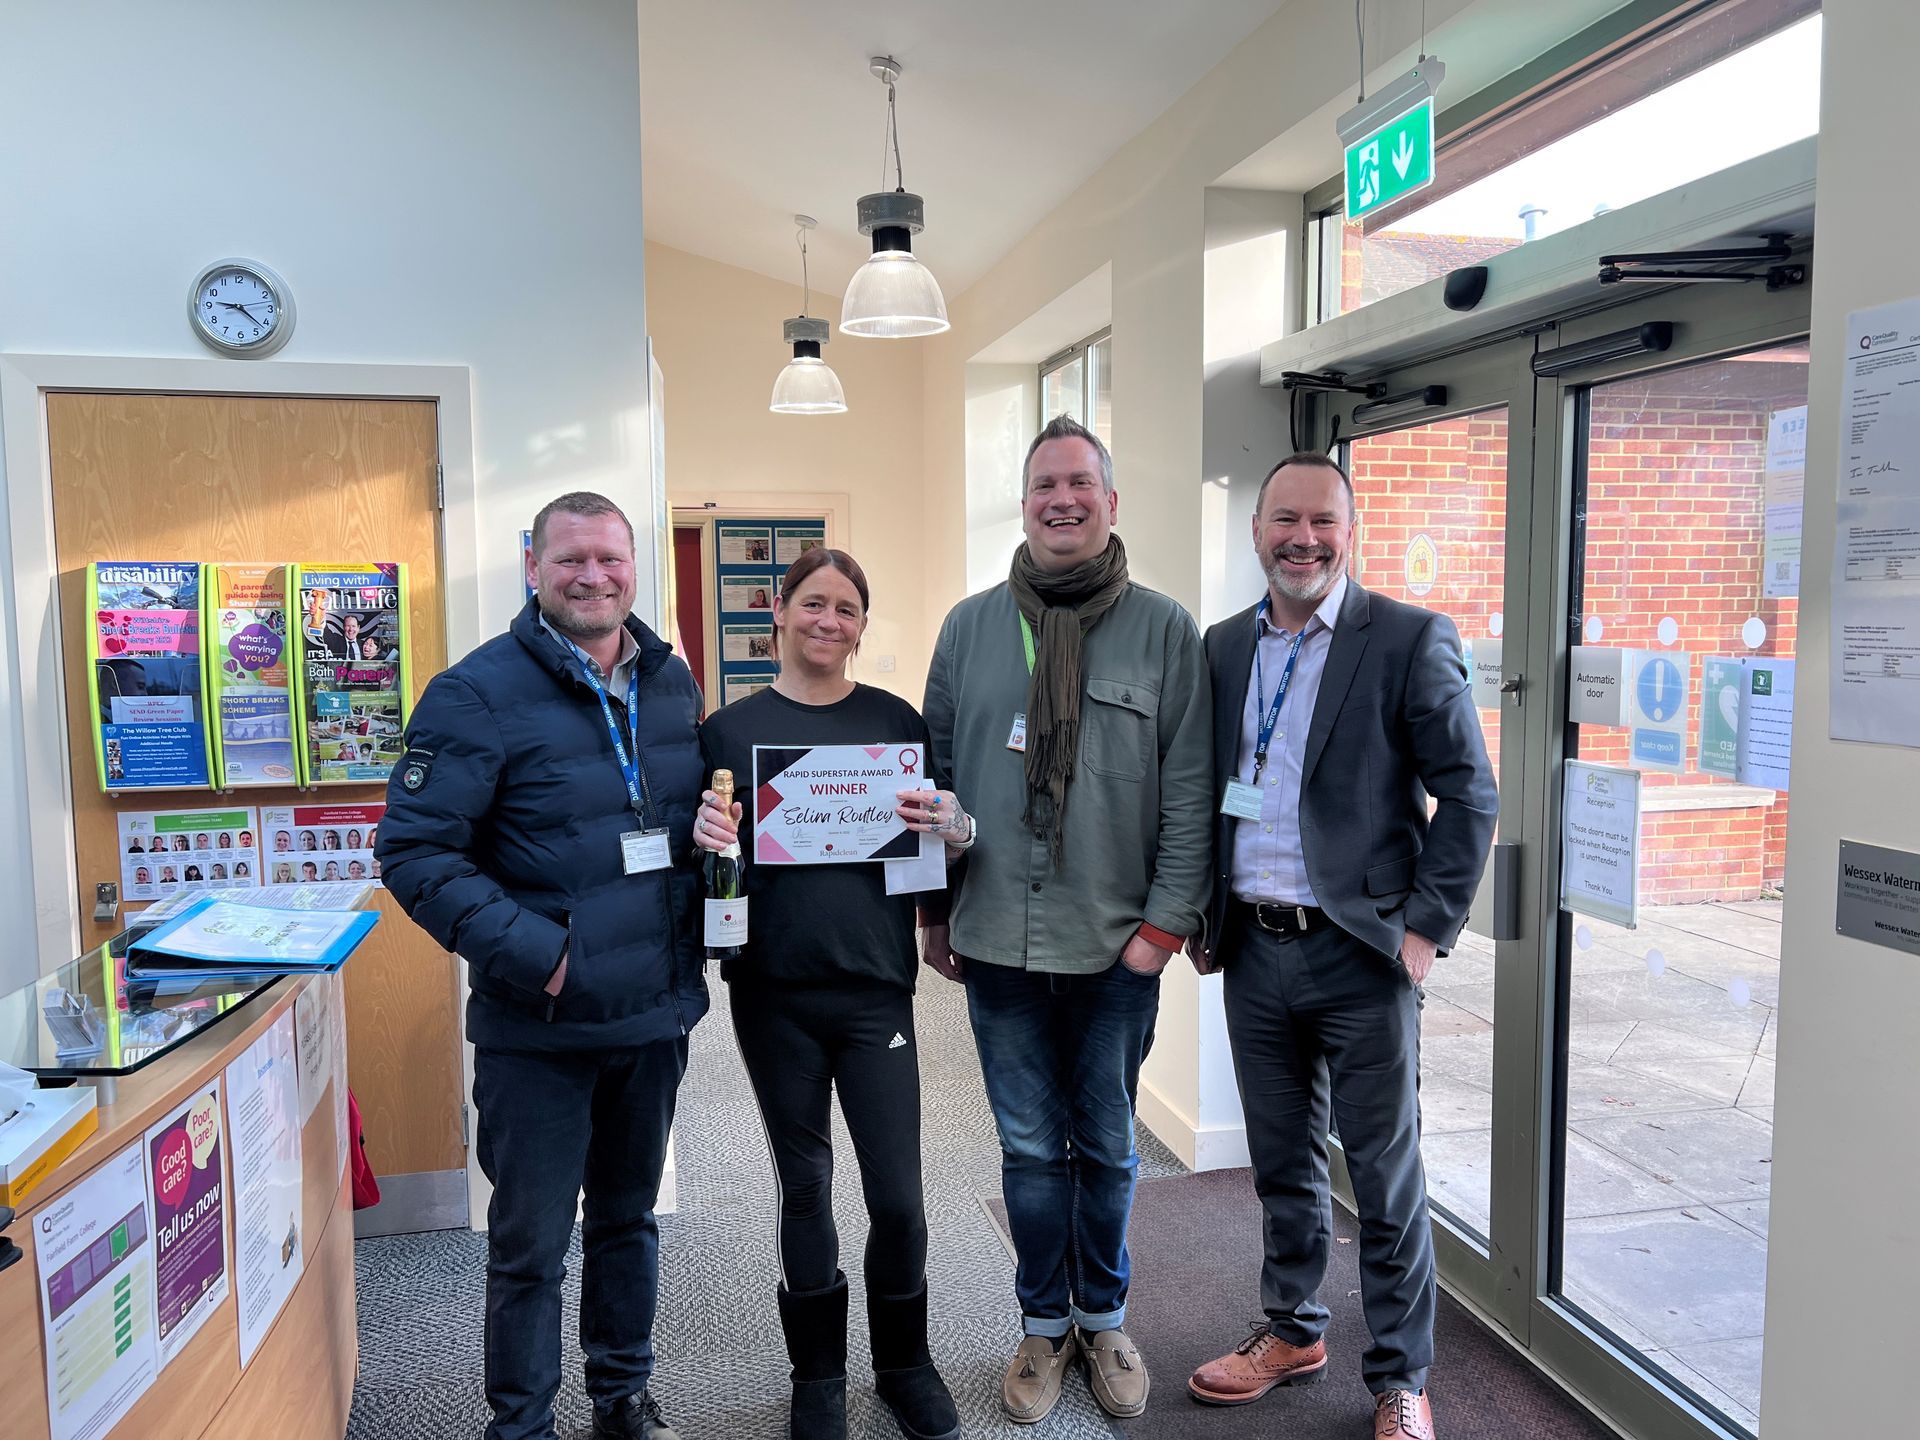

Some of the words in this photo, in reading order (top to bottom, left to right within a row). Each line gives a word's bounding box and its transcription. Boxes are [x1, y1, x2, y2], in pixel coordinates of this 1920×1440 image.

[235, 276, 244, 284] 12
[210, 289, 218, 297] 10
[262, 291, 268, 299] 2
[267, 305, 274, 313] 3
[211, 316, 217, 324] 8
[263, 318, 269, 326] 4
[224, 326, 229, 334] 7
[238, 331, 244, 339] 6
[253, 328, 259, 336] 5
[100, 568, 196, 586] disability
[304, 575, 339, 587] Living
[342, 574, 370, 585] with
[225, 592, 249, 600] guide
[356, 588, 397, 609] Life
[100, 624, 125, 634] Short
[128, 624, 160, 634] Breaks
[163, 624, 198, 634] Bulletin
[239, 635, 267, 643] what's
[238, 644, 276, 655] worrying
[1291, 635, 1302, 658] VISITOR
[245, 655, 270, 663] you?
[309, 667, 334, 677] Bath
[336, 666, 394, 681] Parent
[584, 668, 600, 689] VISITOR
[1577, 673, 1615, 685] Automatic
[1279, 671, 1290, 694] VISITOR
[1485, 676, 1499, 684] door
[1586, 688, 1604, 698] door
[604, 704, 615, 728] VISITOR
[1266, 707, 1278, 729] VISITOR
[616, 742, 628, 767] VISITOR
[784, 770, 809, 778] RAPID
[811, 770, 858, 778] SUPERSTAR
[861, 769, 893, 777] AWARD
[629, 780, 639, 801] VISITO
[810, 783, 868, 795] WINNER
[1586, 797, 1615, 809] Reception
[782, 807, 831, 825] Selina
[837, 806, 893, 825] Routley
[1571, 823, 1587, 833] These
[1588, 827, 1604, 837] doors
[1605, 832, 1619, 840] must
[1621, 835, 1628, 843] be
[1569, 835, 1585, 845] locked
[1587, 840, 1601, 849] when
[1602, 843, 1630, 857] Reception
[820, 849, 858, 858] Rapidclean
[1586, 854, 1617, 867] unattended
[1844, 864, 1881, 883] Wessex
[1584, 880, 1600, 890] Thank
[1602, 885, 1613, 896] You
[1871, 888, 1899, 899] together
[1874, 920, 1899, 932] Wessex
[192, 1107, 210, 1132] Poor
[194, 1120, 214, 1149] care?
[161, 1140, 186, 1174] Good
[163, 1160, 187, 1194] care?
[158, 1214, 178, 1253] Tell
[180, 1207, 194, 1233] us
[196, 1183, 220, 1216] now
[46, 1241, 66, 1262] Fairfield
[67, 1234, 79, 1246] Farm
[79, 1220, 96, 1236] College
